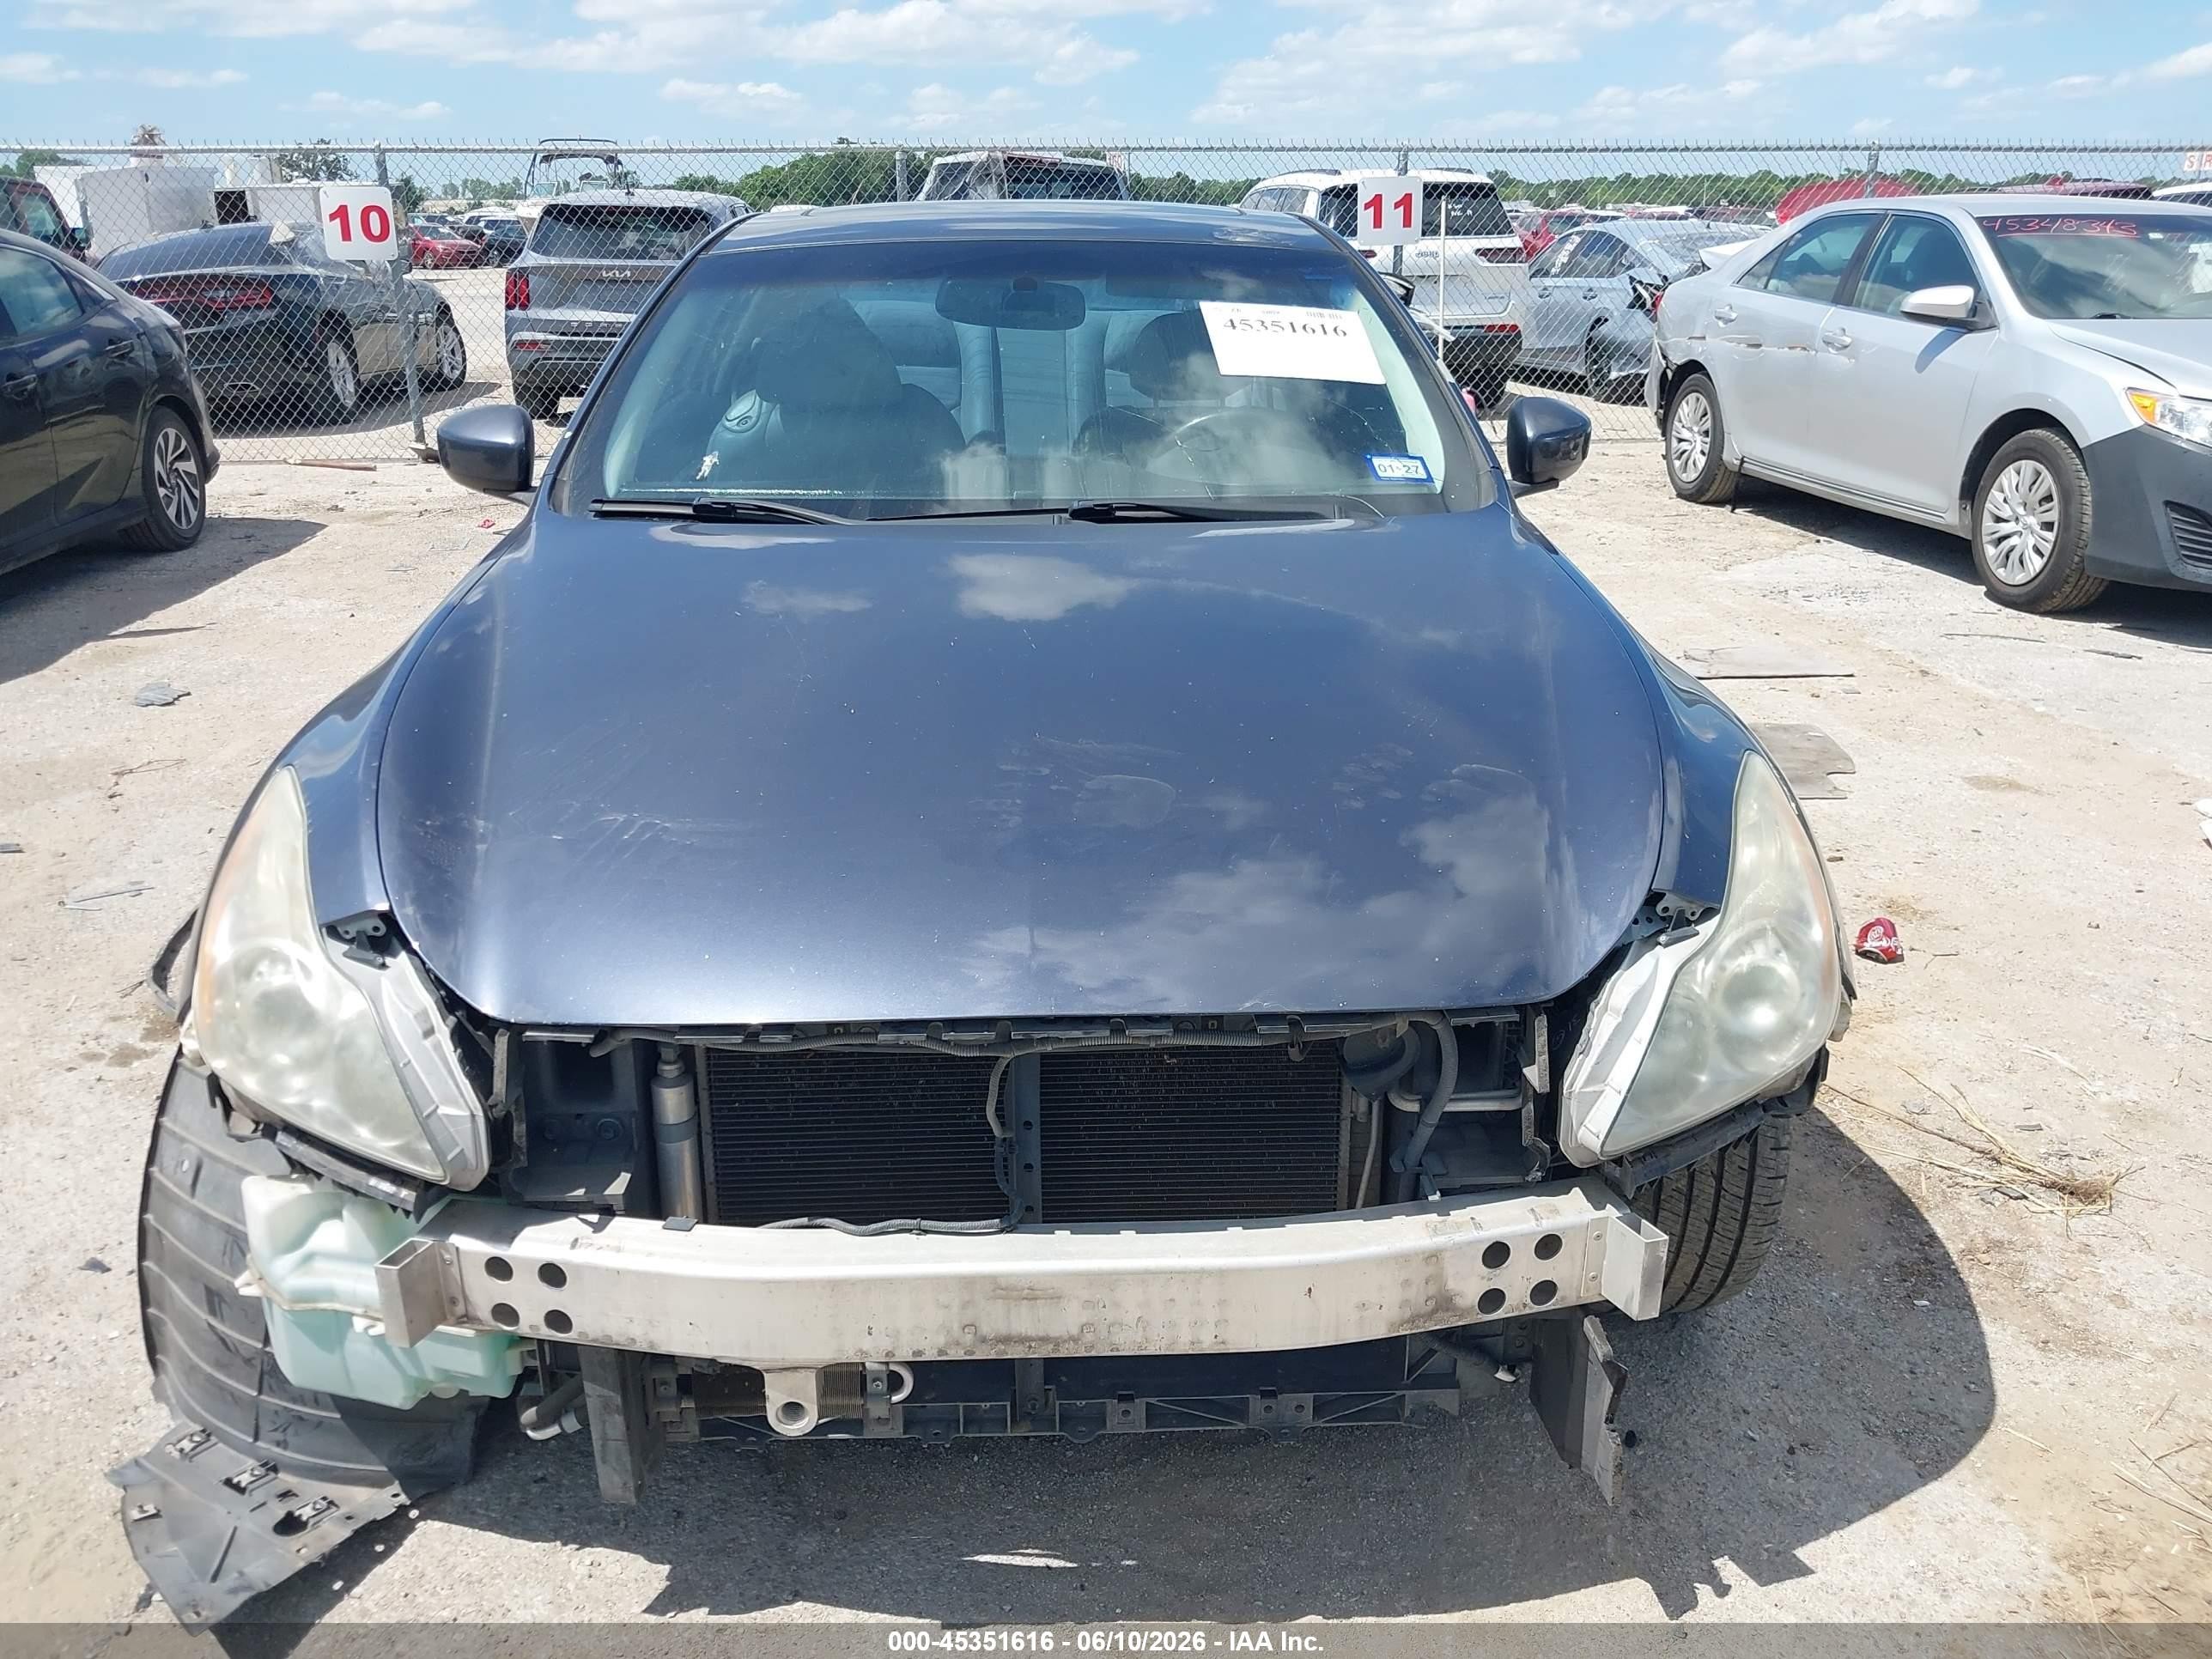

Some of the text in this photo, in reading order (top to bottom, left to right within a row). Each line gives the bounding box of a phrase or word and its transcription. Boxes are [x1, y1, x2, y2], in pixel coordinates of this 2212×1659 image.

[328, 204, 392, 244] 10
[1363, 191, 1414, 230] 11
[1223, 318, 1347, 337] 45351616
